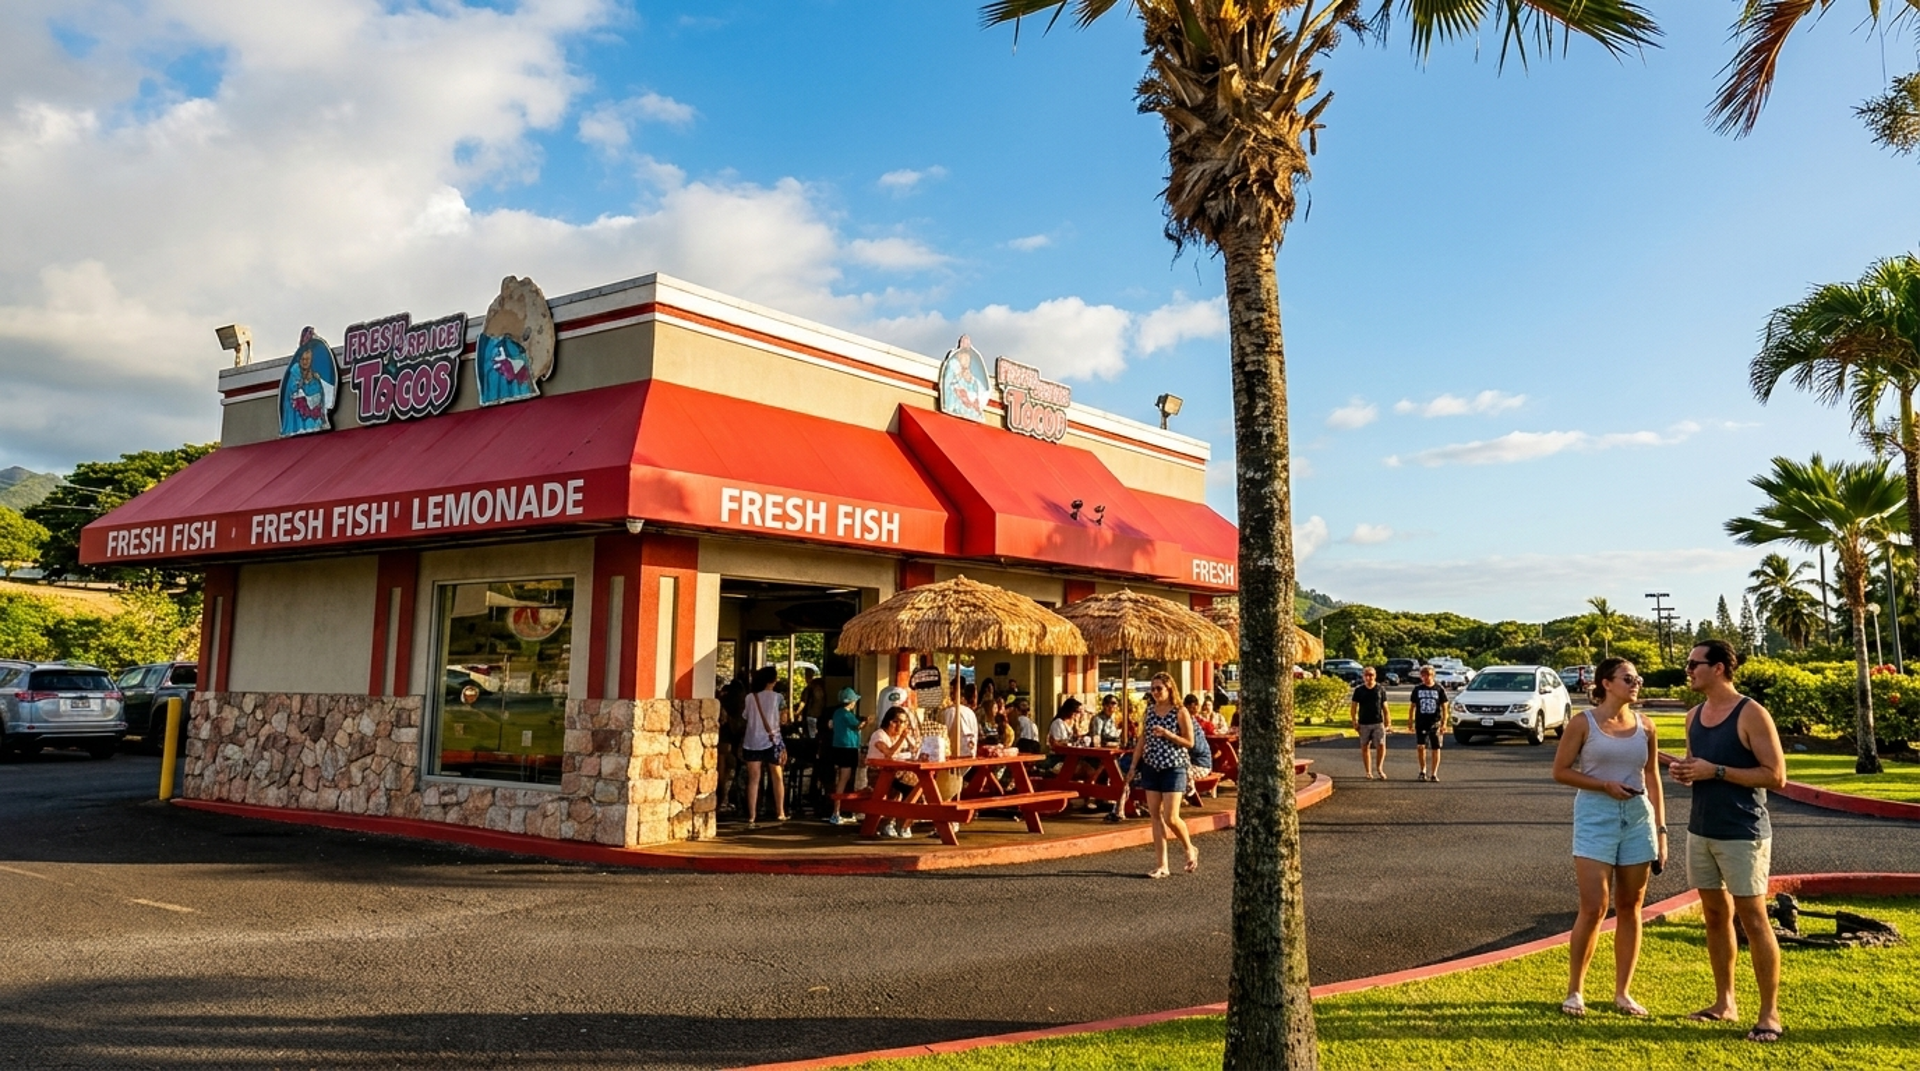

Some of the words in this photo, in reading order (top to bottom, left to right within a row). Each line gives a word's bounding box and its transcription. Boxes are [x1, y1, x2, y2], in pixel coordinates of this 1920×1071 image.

[346, 320, 407, 362] FRESH
[354, 358, 452, 417] TACOS
[106, 525, 167, 558] FRESH
[171, 520, 218, 552] FISH
[250, 508, 325, 545] FRESH
[331, 500, 389, 539] FISH
[411, 478, 585, 531] LEMONADE
[720, 486, 828, 536] FRESH
[836, 503, 901, 545] FISH
[1192, 558, 1235, 587] FRESH
